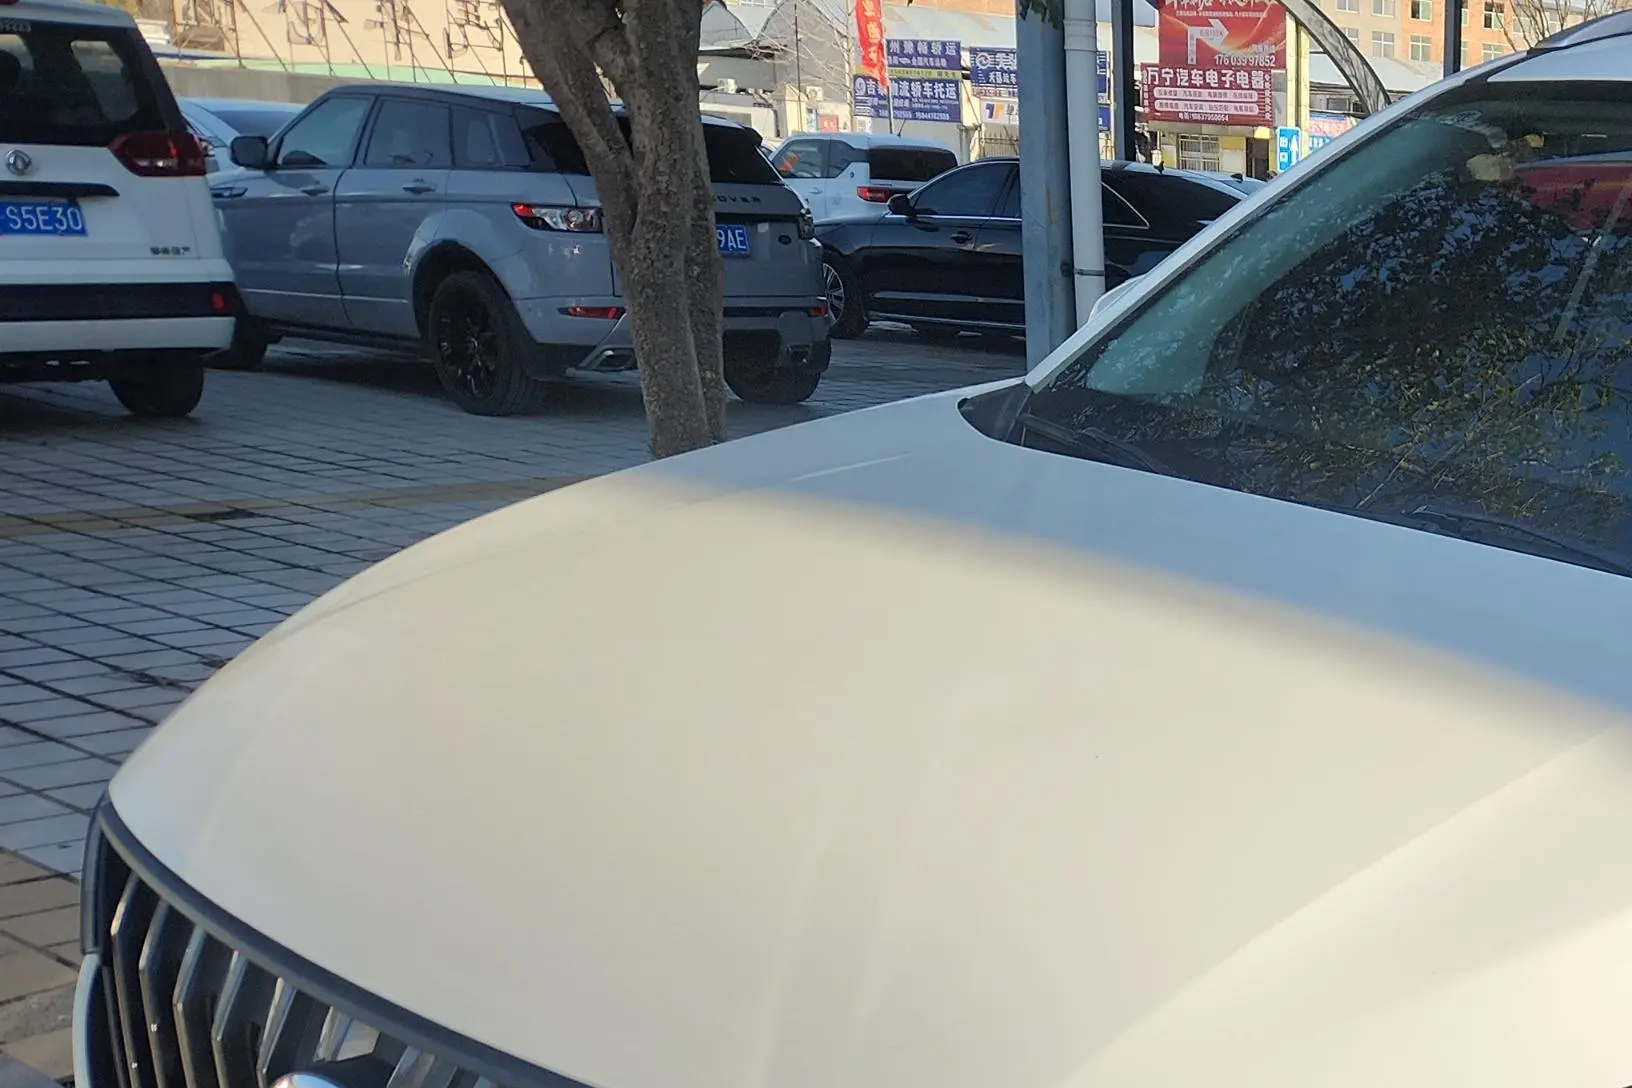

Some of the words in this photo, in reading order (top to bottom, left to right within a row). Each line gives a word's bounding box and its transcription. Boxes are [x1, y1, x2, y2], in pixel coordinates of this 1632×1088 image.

[1147, 67, 1264, 89] 万宁汽车电子电器
[6, 205, 82, 231] S5E30
